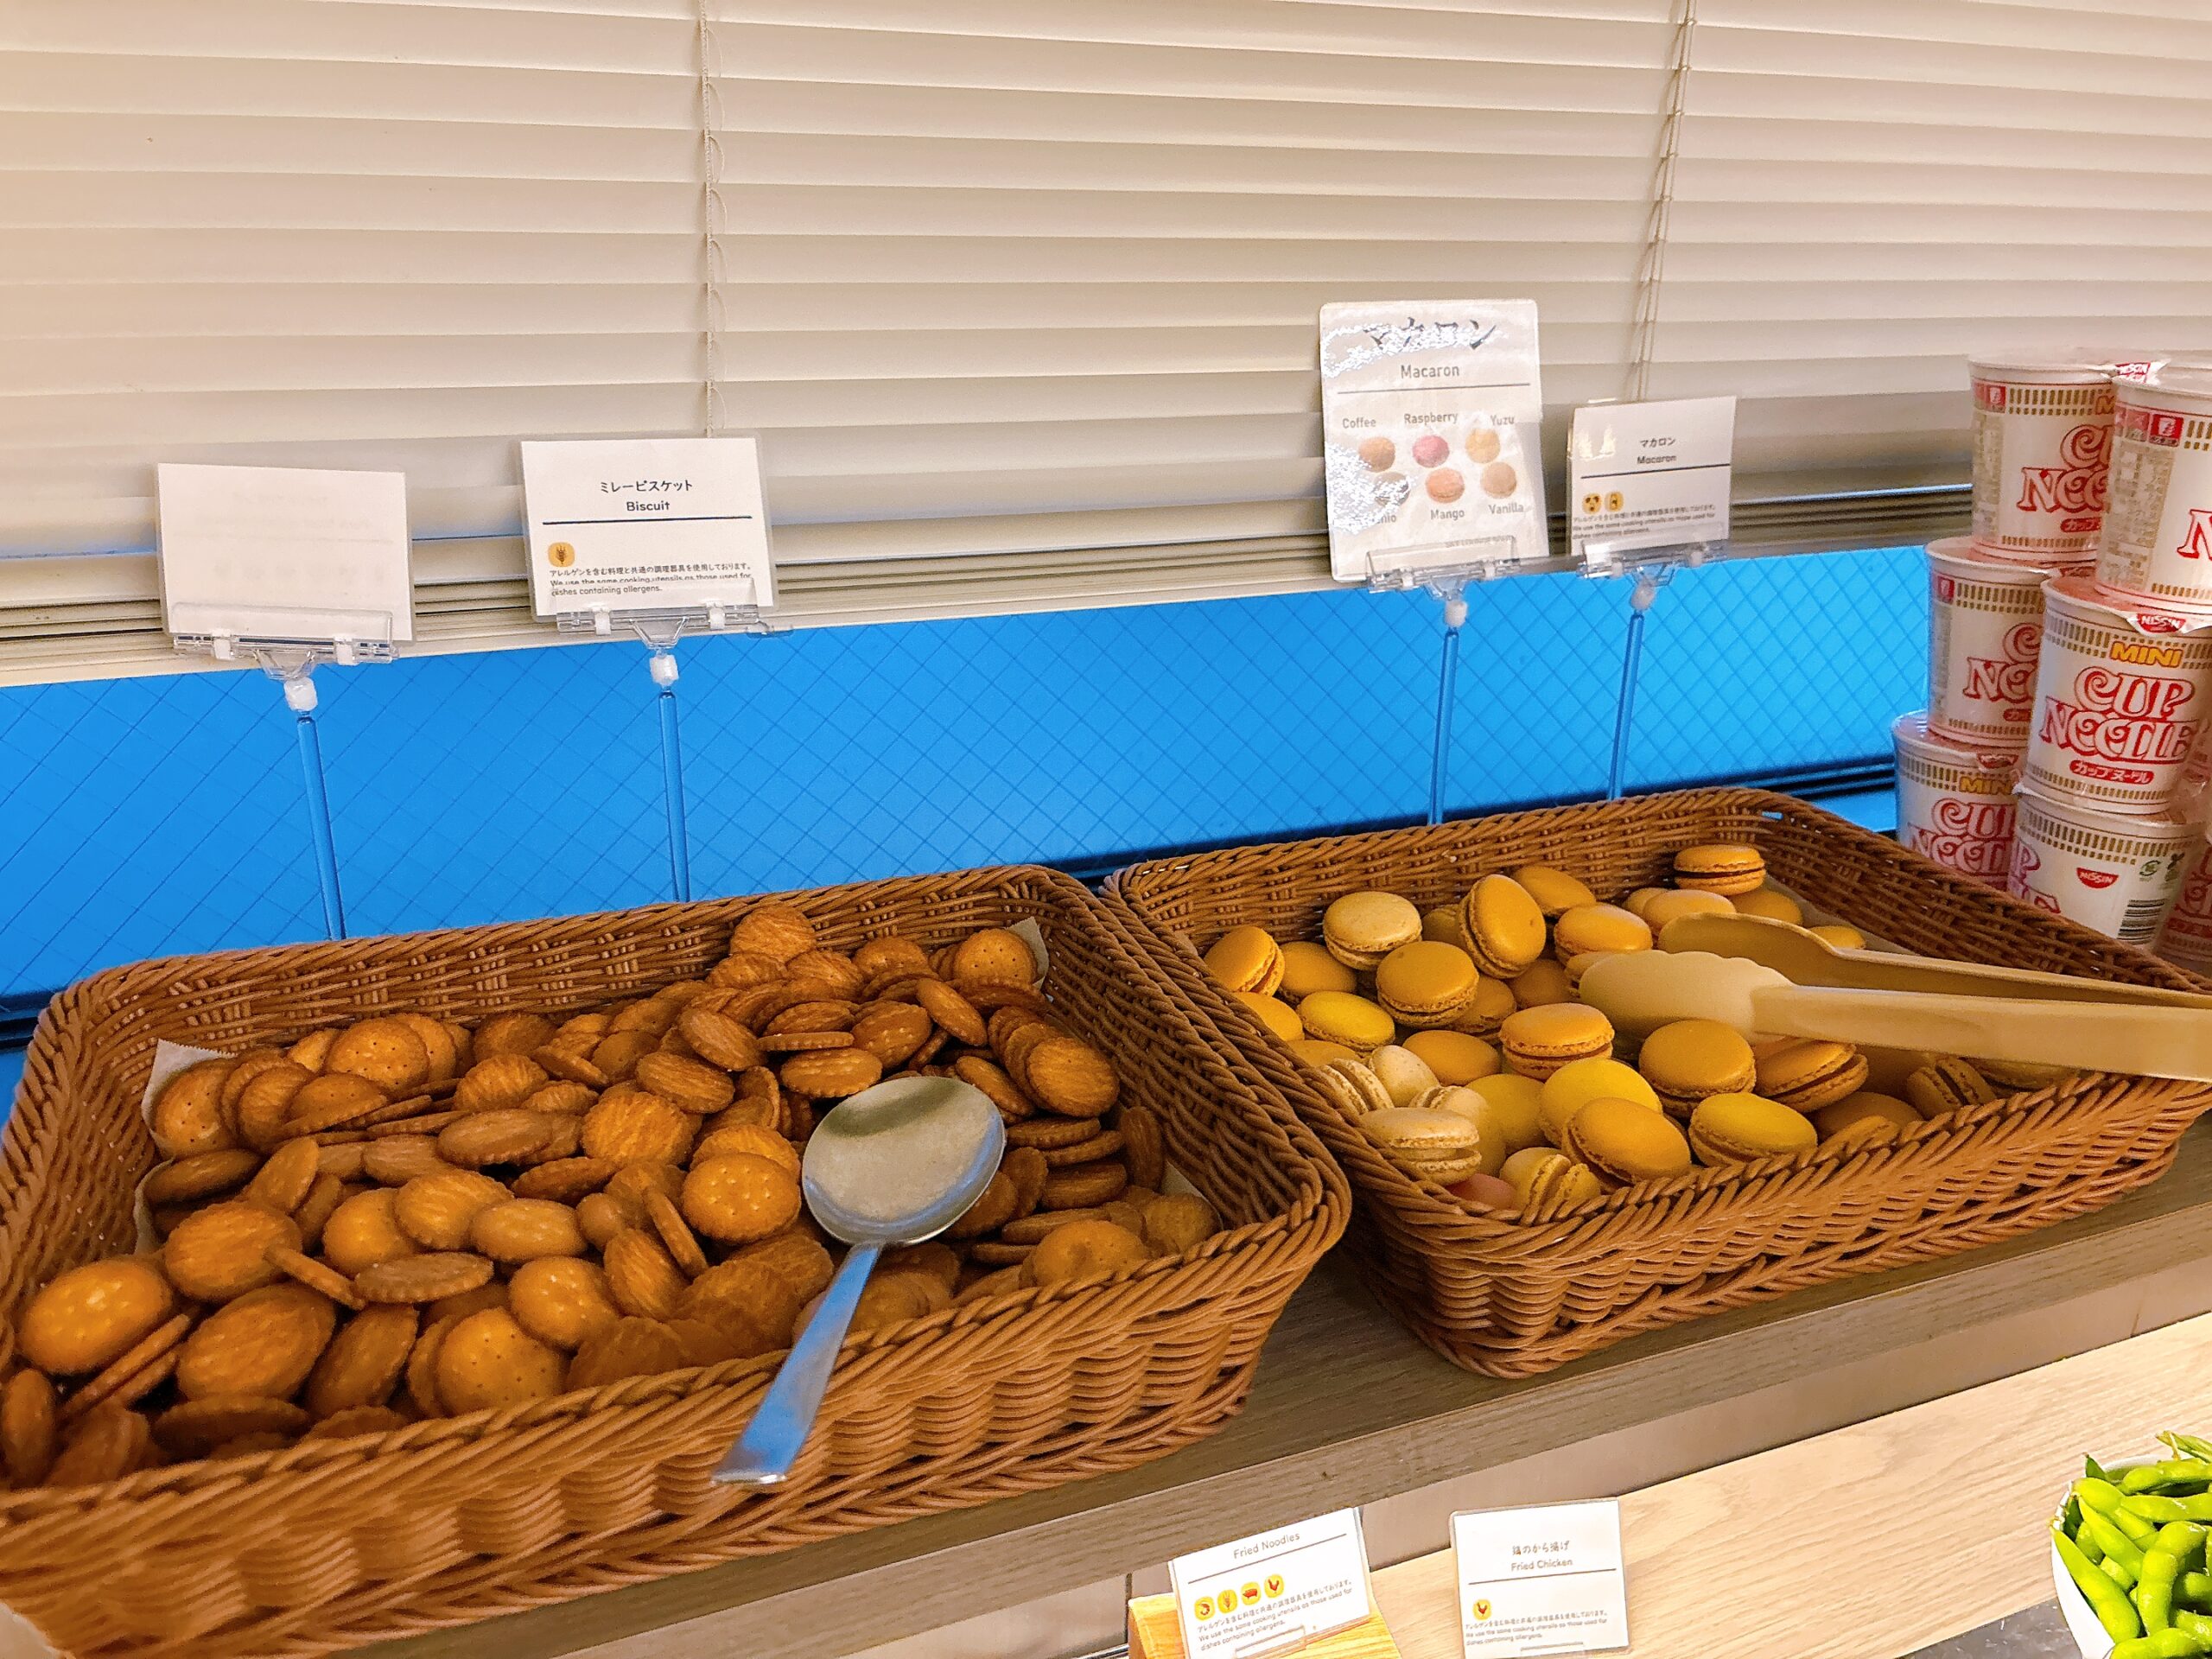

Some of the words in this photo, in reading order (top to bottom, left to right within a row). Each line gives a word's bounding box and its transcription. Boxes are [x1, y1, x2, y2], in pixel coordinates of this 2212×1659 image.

[1401, 365, 1459, 378] Macaron
[1342, 418, 1376, 429] Coffee
[1403, 411, 1459, 424] Raspberry
[1490, 415, 1515, 425] Yuzu
[1639, 437, 1676, 448] マカロン
[1637, 455, 1676, 464] Macaron
[626, 500, 670, 512] Biscuit
[1430, 509, 1465, 520] Mango
[1488, 503, 1523, 514] Vanilla
[2140, 614, 2181, 628] NISSIN
[2109, 641, 2183, 668] MINI
[2075, 666, 2195, 721] CUP
[1958, 777, 2013, 795] MIN
[1931, 798, 2016, 840] CU
[2079, 871, 2113, 885] NISSIN
[1234, 1543, 1259, 1559] Fried
[1262, 1533, 1300, 1550] Noodles
[1510, 1561, 1535, 1572] Fried
[1536, 1559, 1573, 1569] Chicken
